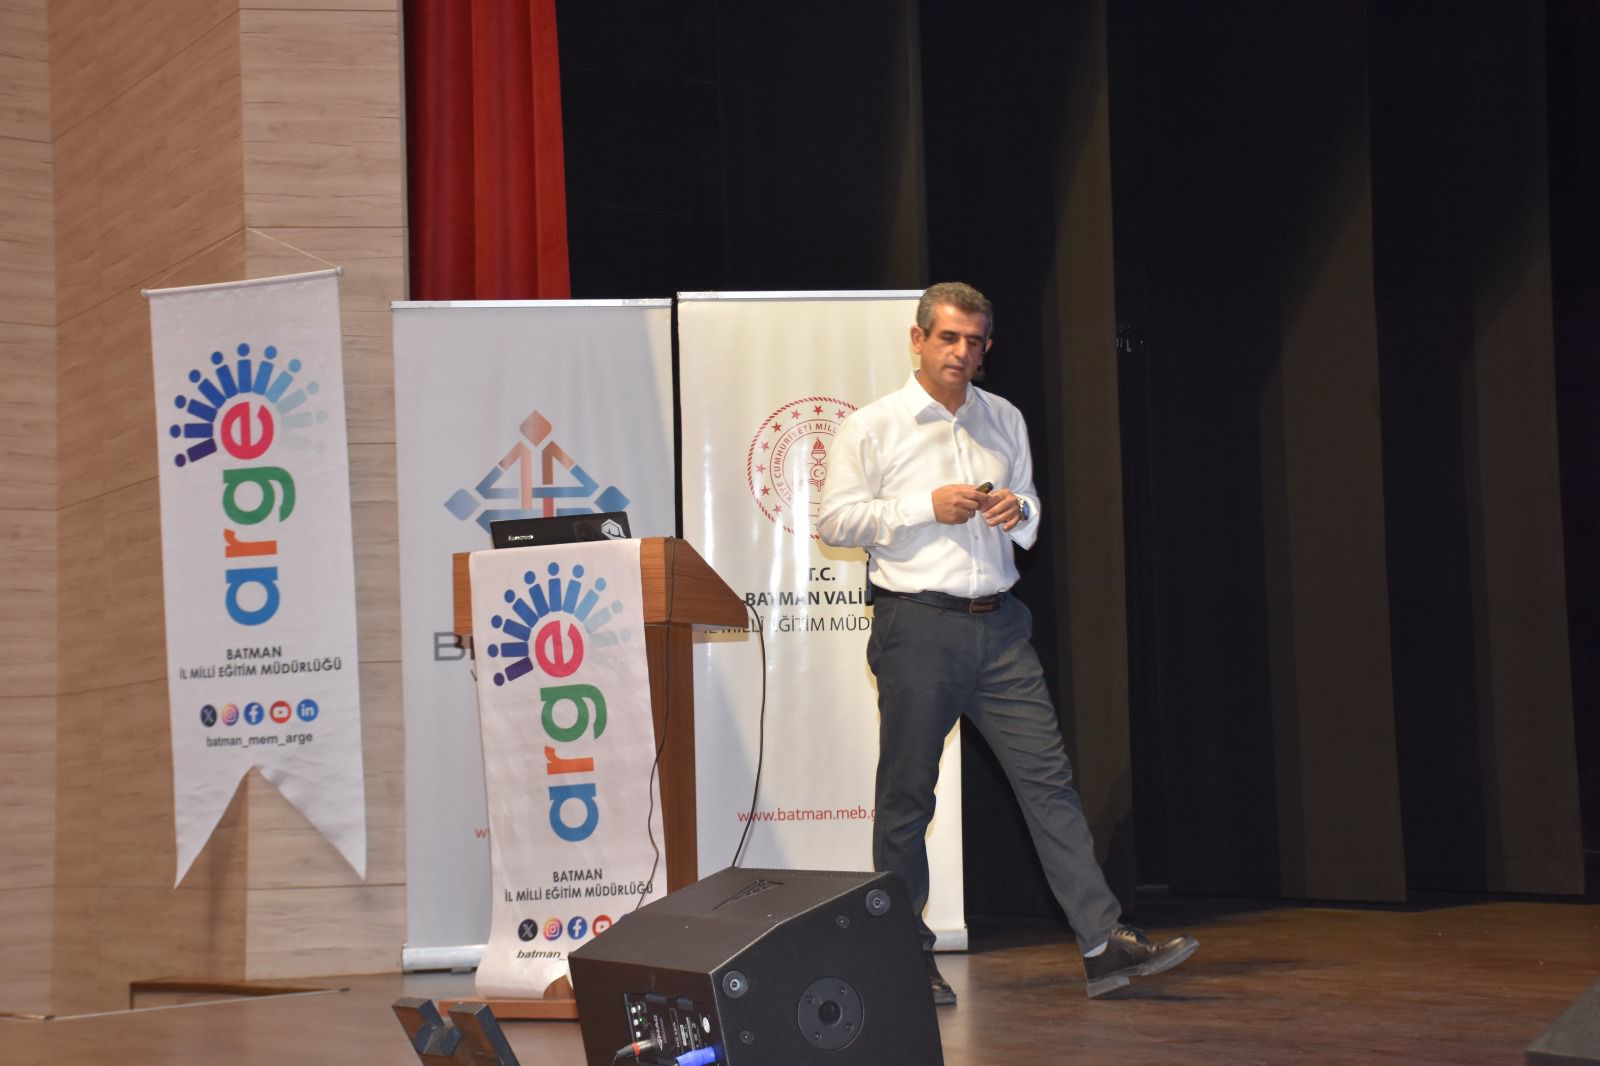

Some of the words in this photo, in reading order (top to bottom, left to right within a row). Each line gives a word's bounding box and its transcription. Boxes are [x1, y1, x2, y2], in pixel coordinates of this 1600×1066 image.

[221, 401, 296, 626] arge
[830, 613, 874, 631] MÜD
[226, 646, 282, 660] BATMAN
[218, 663, 256, 678] EĞİTİM
[260, 656, 342, 676] MÜDÜRLÜĞÜ
[206, 731, 313, 748] batman_mem_arge
[535, 619, 607, 843] arge
[552, 868, 603, 882] BATMAN
[504, 889, 513, 902] İL
[516, 887, 542, 902] MİLLİ
[545, 885, 582, 900] EĞİTİM
[585, 881, 653, 898] MÜDÜRLÜĞÜ
